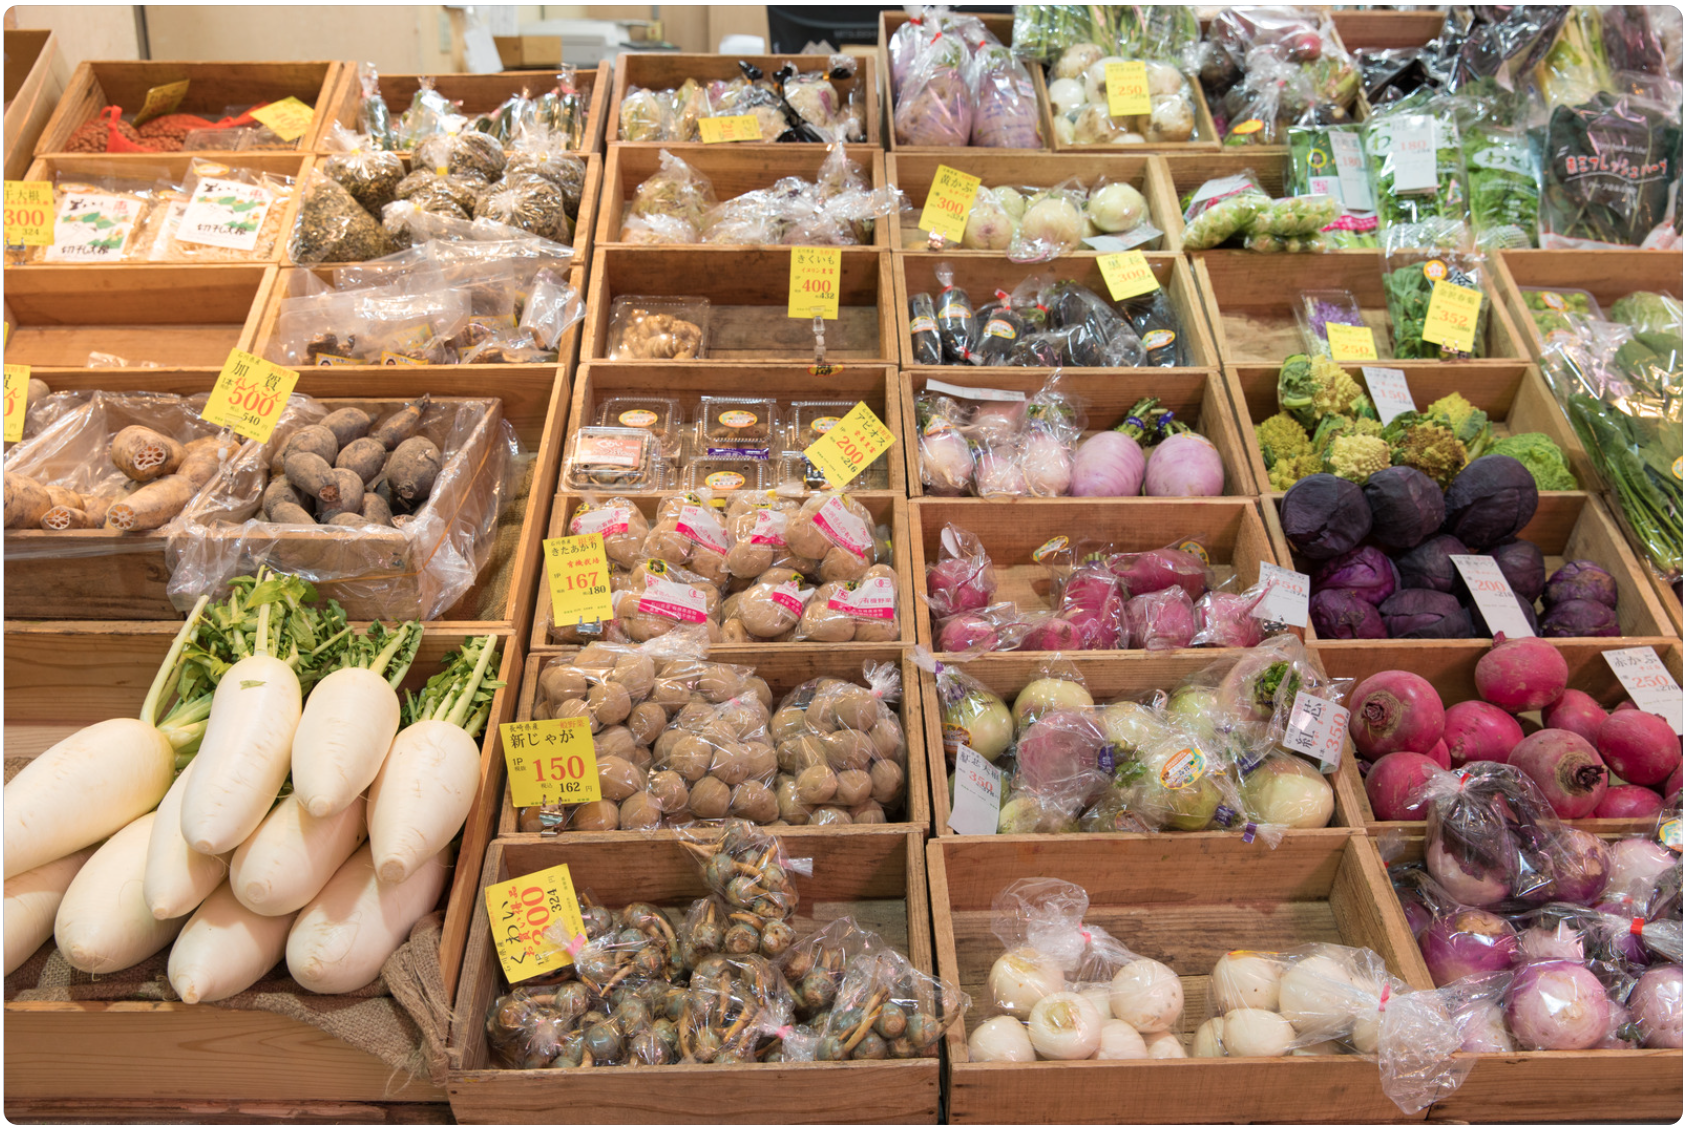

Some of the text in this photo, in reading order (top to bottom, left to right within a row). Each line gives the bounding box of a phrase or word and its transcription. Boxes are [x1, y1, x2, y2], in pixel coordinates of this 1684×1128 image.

[1400, 140, 1427, 152] 180
[936, 197, 964, 216] 300
[797, 254, 835, 265] きくいも
[1117, 268, 1146, 283] 300
[801, 279, 832, 293] 400
[1439, 309, 1469, 327] 352
[1341, 343, 1369, 354] 250
[233, 376, 283, 403] れんこん
[1380, 388, 1406, 400] 150
[228, 384, 275, 418] 500
[243, 412, 261, 426] 540
[836, 435, 864, 465] 200
[843, 457, 859, 473] 216
[551, 541, 597, 557] きたあかり
[566, 570, 599, 591] 167
[1475, 580, 1507, 592] 200
[589, 585, 607, 595] 180
[1614, 655, 1657, 668] 赤かぶ
[1631, 675, 1669, 688] 250
[510, 728, 575, 749] 新じゃが
[1326, 713, 1346, 753] 350
[512, 757, 524, 766] 1P
[532, 755, 585, 783] 150
[560, 781, 581, 794] 162
[970, 770, 993, 793] 350
[546, 888, 562, 913] 324
[508, 886, 536, 957] お買い得品
[502, 900, 527, 965] くわい
